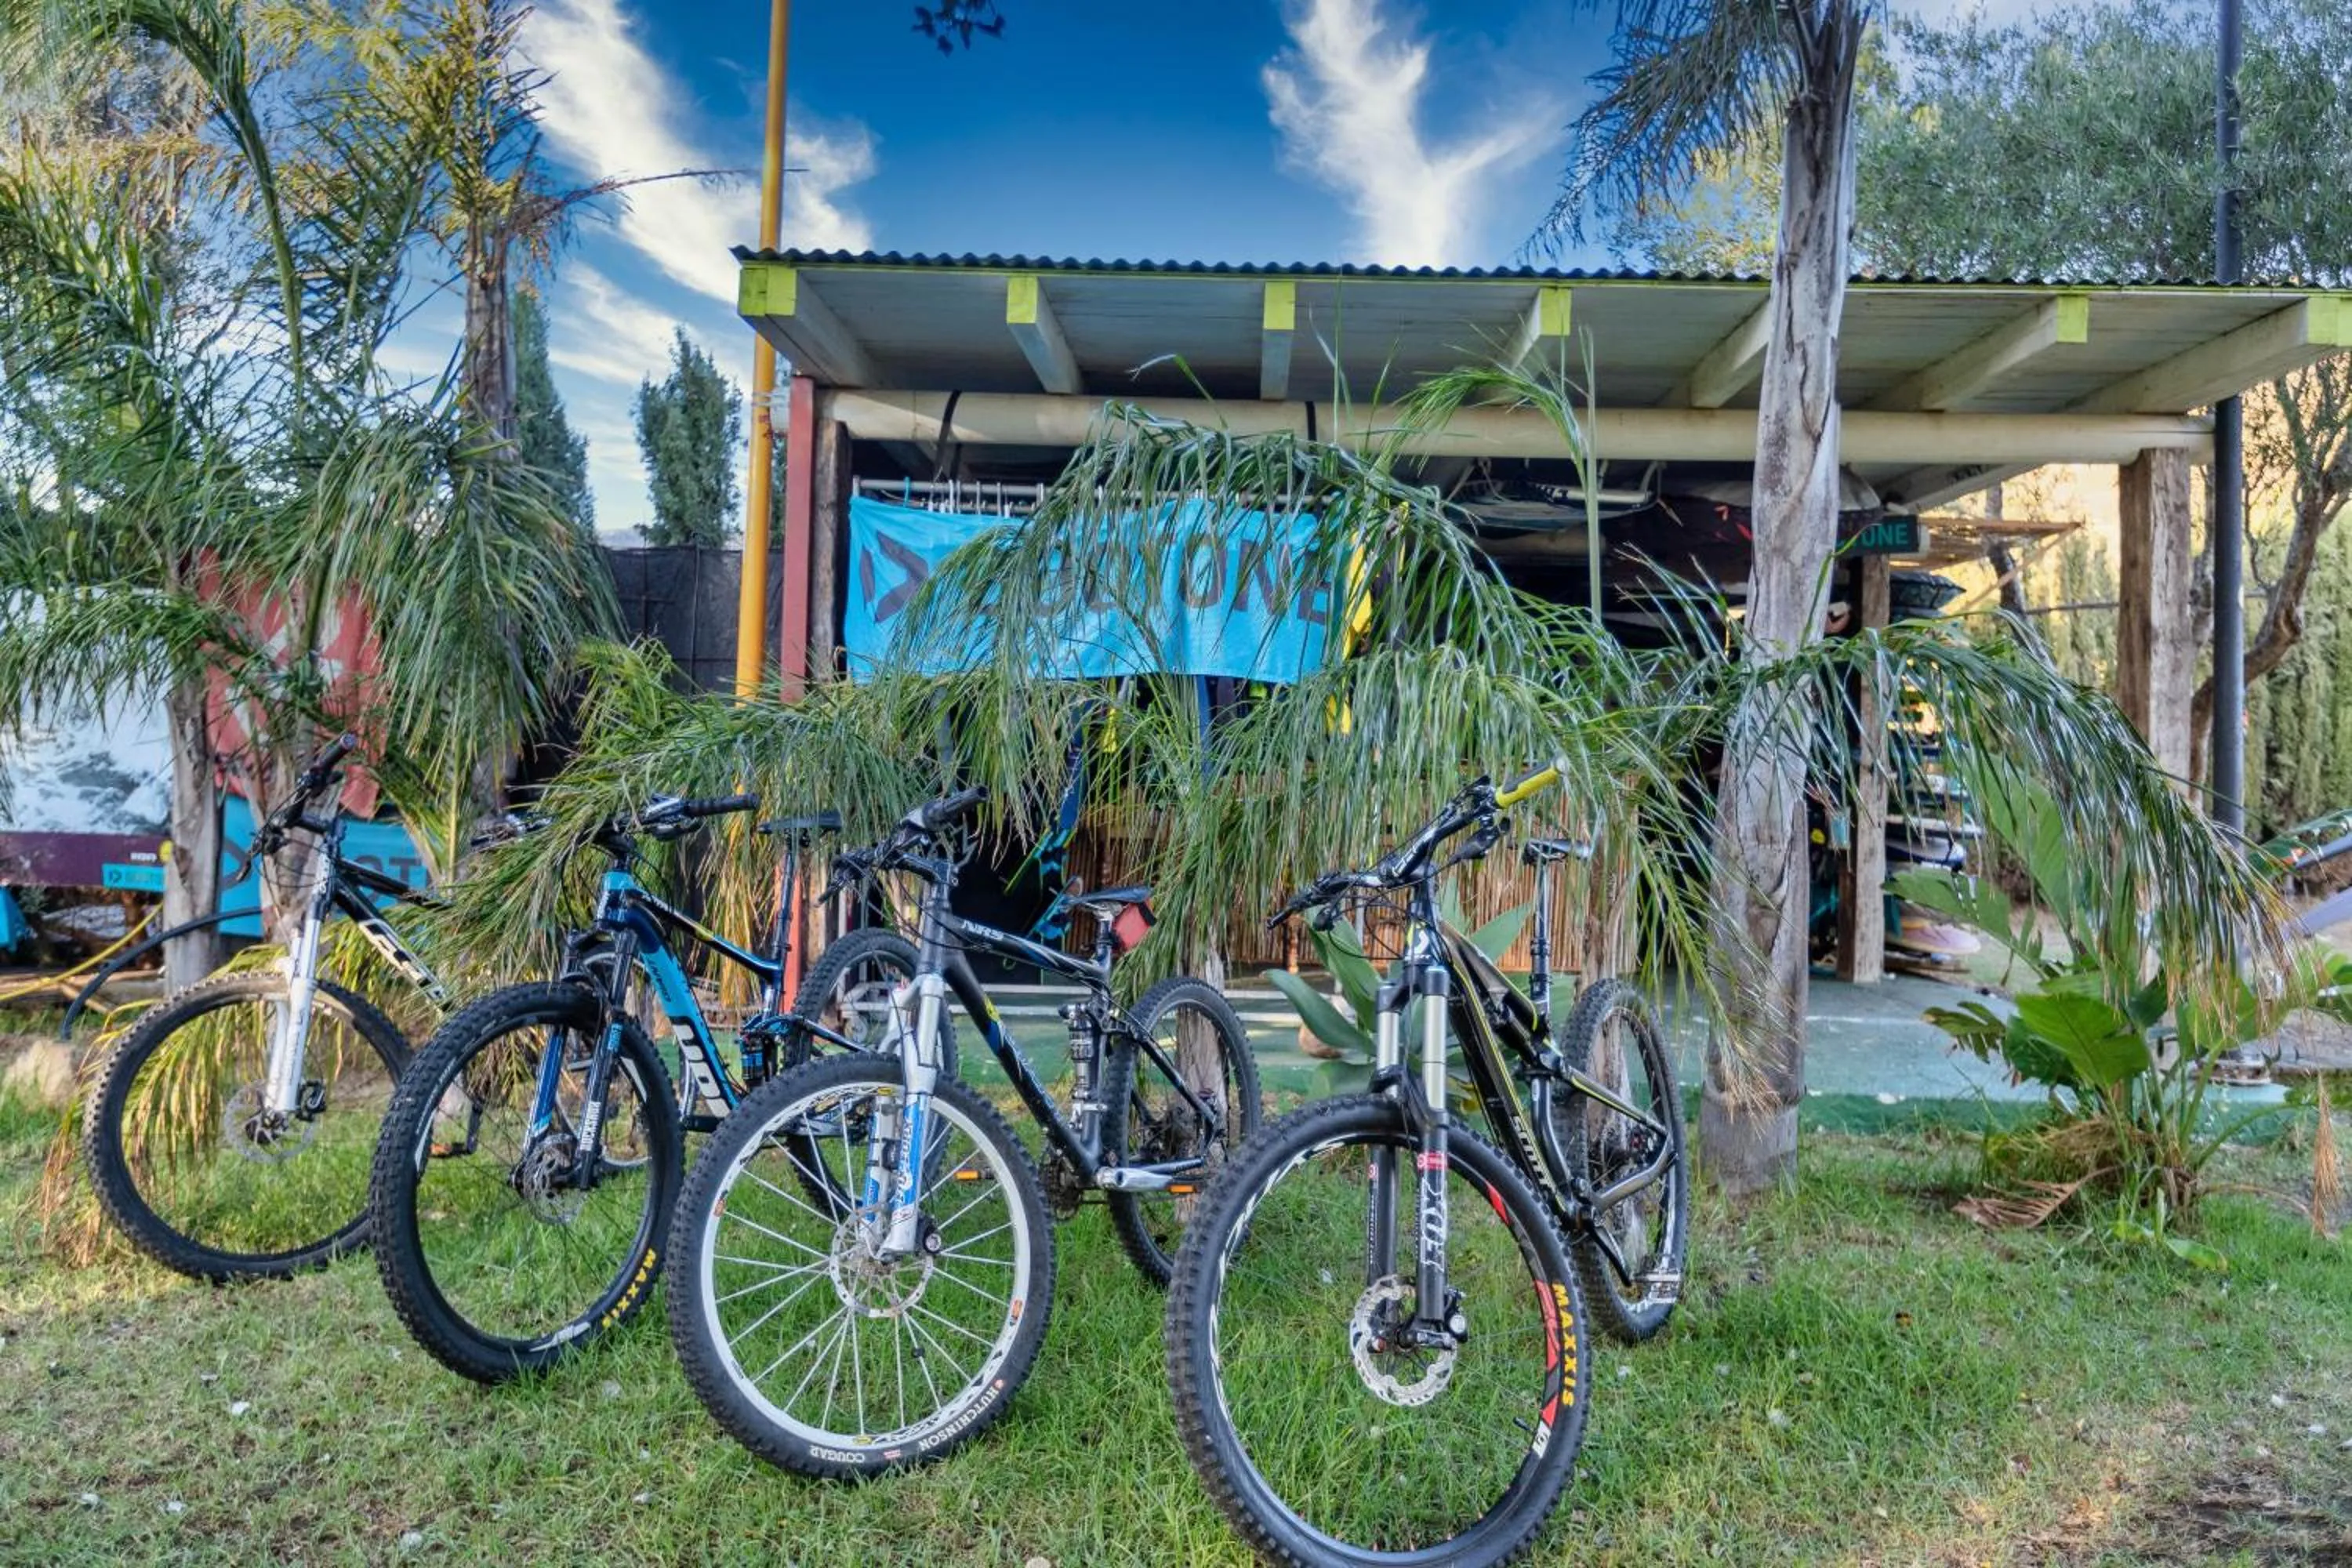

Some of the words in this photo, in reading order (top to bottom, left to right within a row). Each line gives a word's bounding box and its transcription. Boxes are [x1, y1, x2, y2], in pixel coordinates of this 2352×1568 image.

[1420, 1176, 1448, 1273] FOX
[1552, 1282, 1577, 1407] MAXXIS
[809, 1444, 866, 1463] COUGAR
[918, 1385, 1000, 1452] HUTCHINSON
